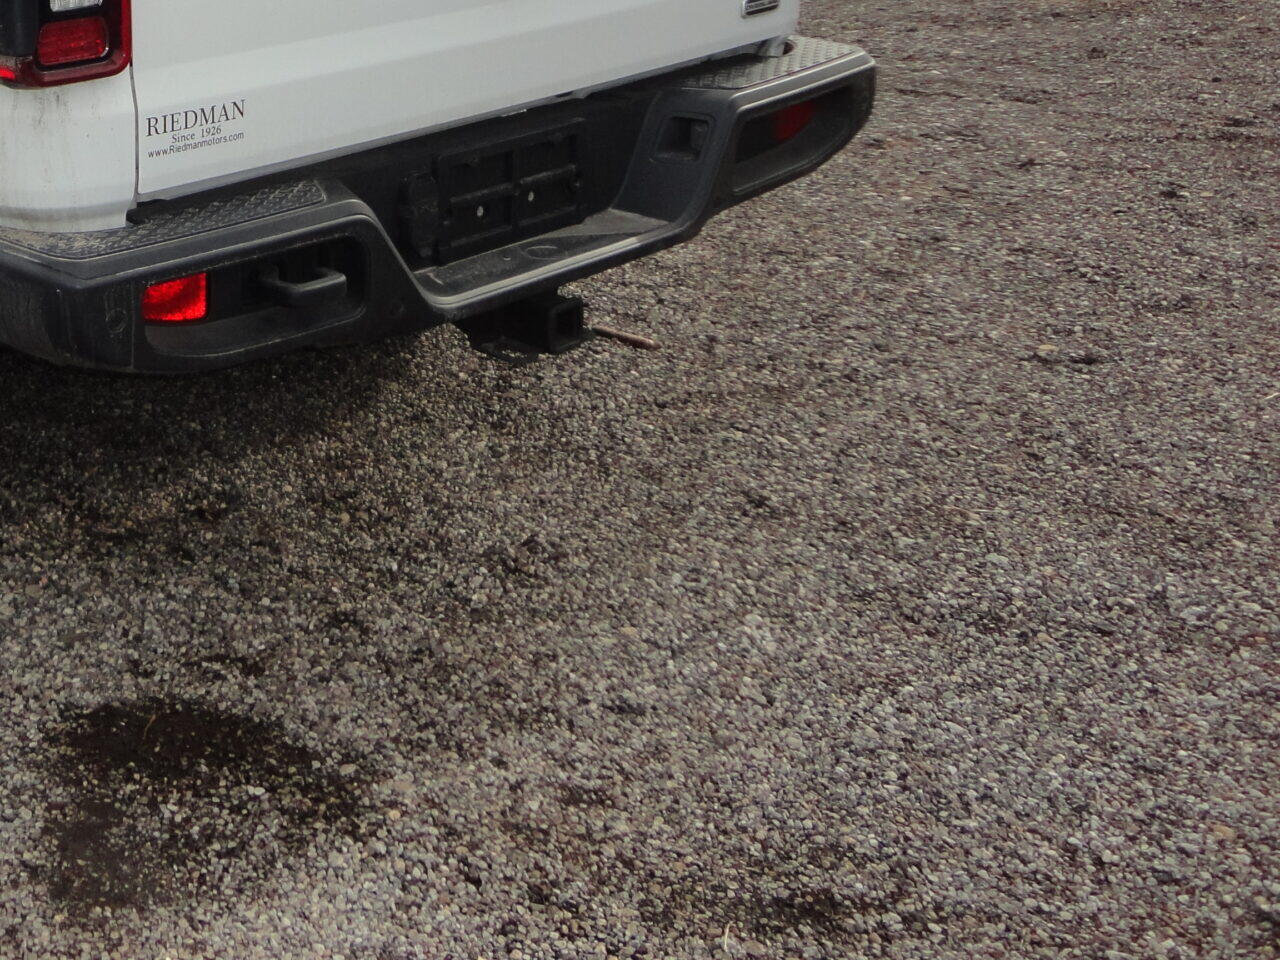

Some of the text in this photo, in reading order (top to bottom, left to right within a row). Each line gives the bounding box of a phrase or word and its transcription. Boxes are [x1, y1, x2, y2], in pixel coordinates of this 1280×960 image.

[146, 99, 246, 137] RIEDMAN
[147, 131, 245, 158] www.Riedmanmotors.com
[171, 125, 222, 144] Since 1926
